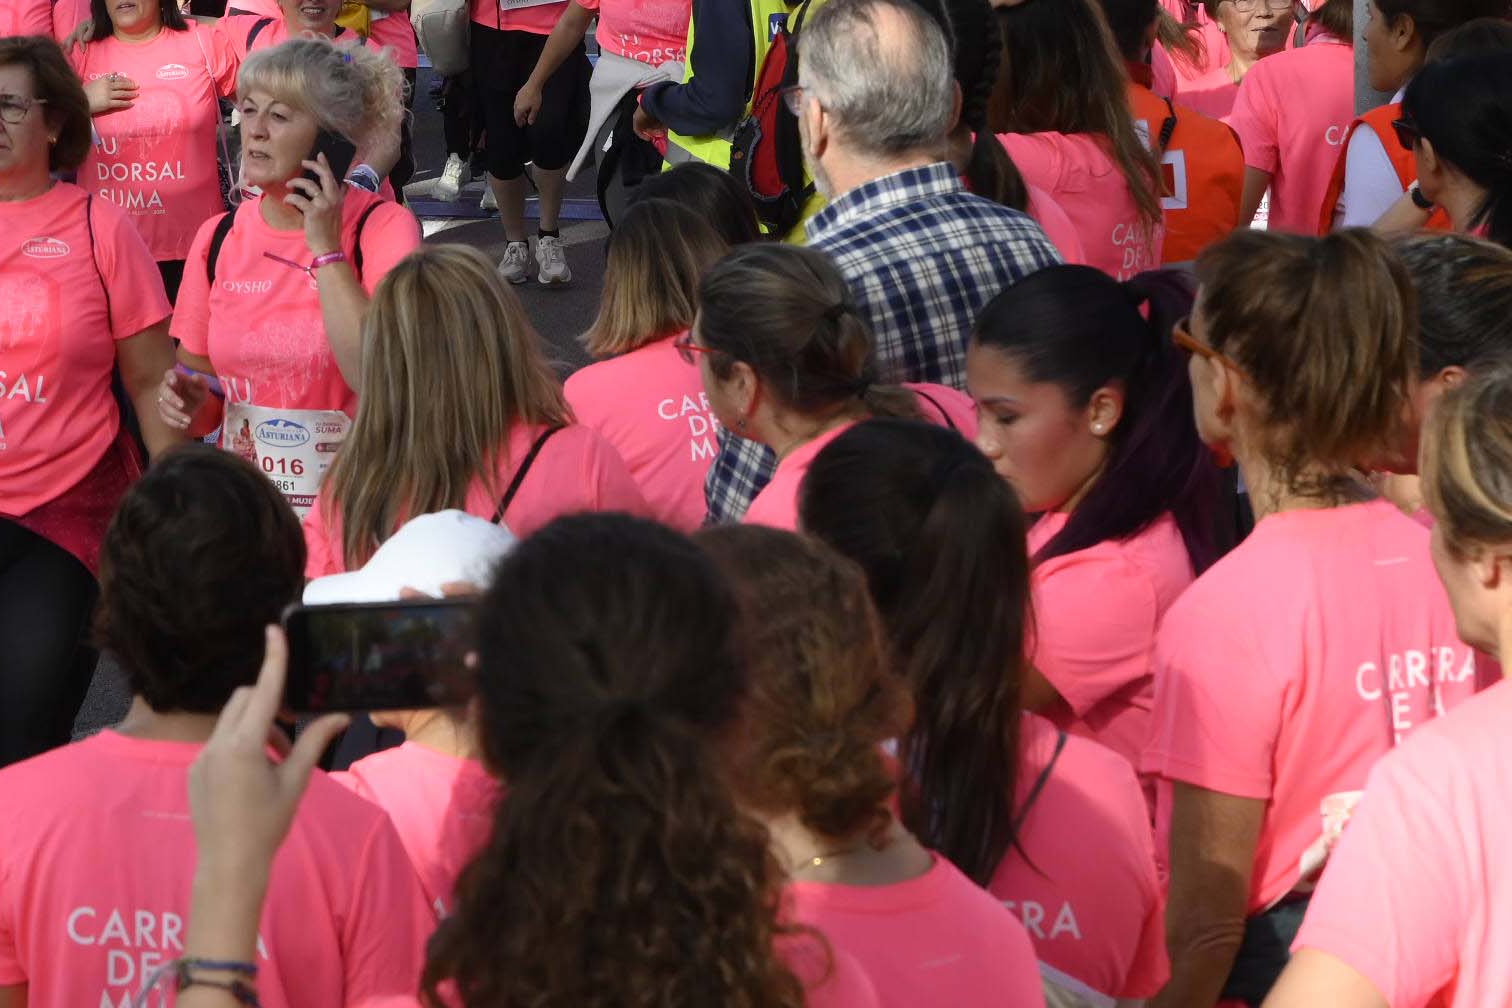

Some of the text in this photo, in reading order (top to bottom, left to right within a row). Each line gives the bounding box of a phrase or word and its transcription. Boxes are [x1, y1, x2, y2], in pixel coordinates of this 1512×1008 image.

[97, 160, 185, 182] DORSAL
[259, 427, 306, 441] ASTURIANA
[262, 456, 304, 475] 016
